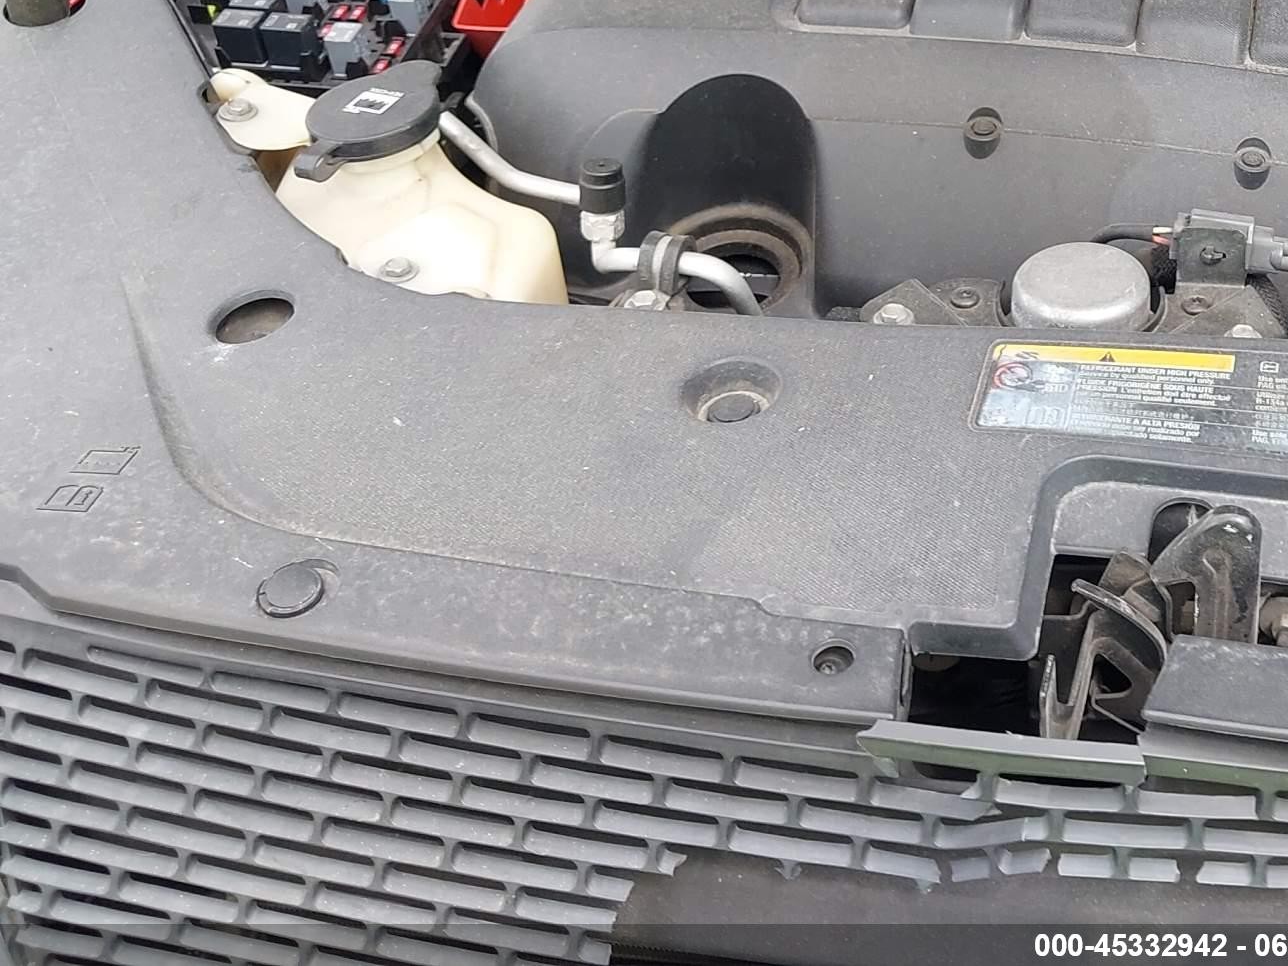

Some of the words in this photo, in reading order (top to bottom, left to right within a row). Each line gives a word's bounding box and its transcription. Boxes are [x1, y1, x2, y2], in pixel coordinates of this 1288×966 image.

[1157, 375, 1196, 384] personnel
[1189, 369, 1232, 380] PRESSURE
[1162, 383, 1186, 392] SOUS
[1187, 384, 1215, 394] HAUTE
[1141, 417, 1164, 427] ALTA
